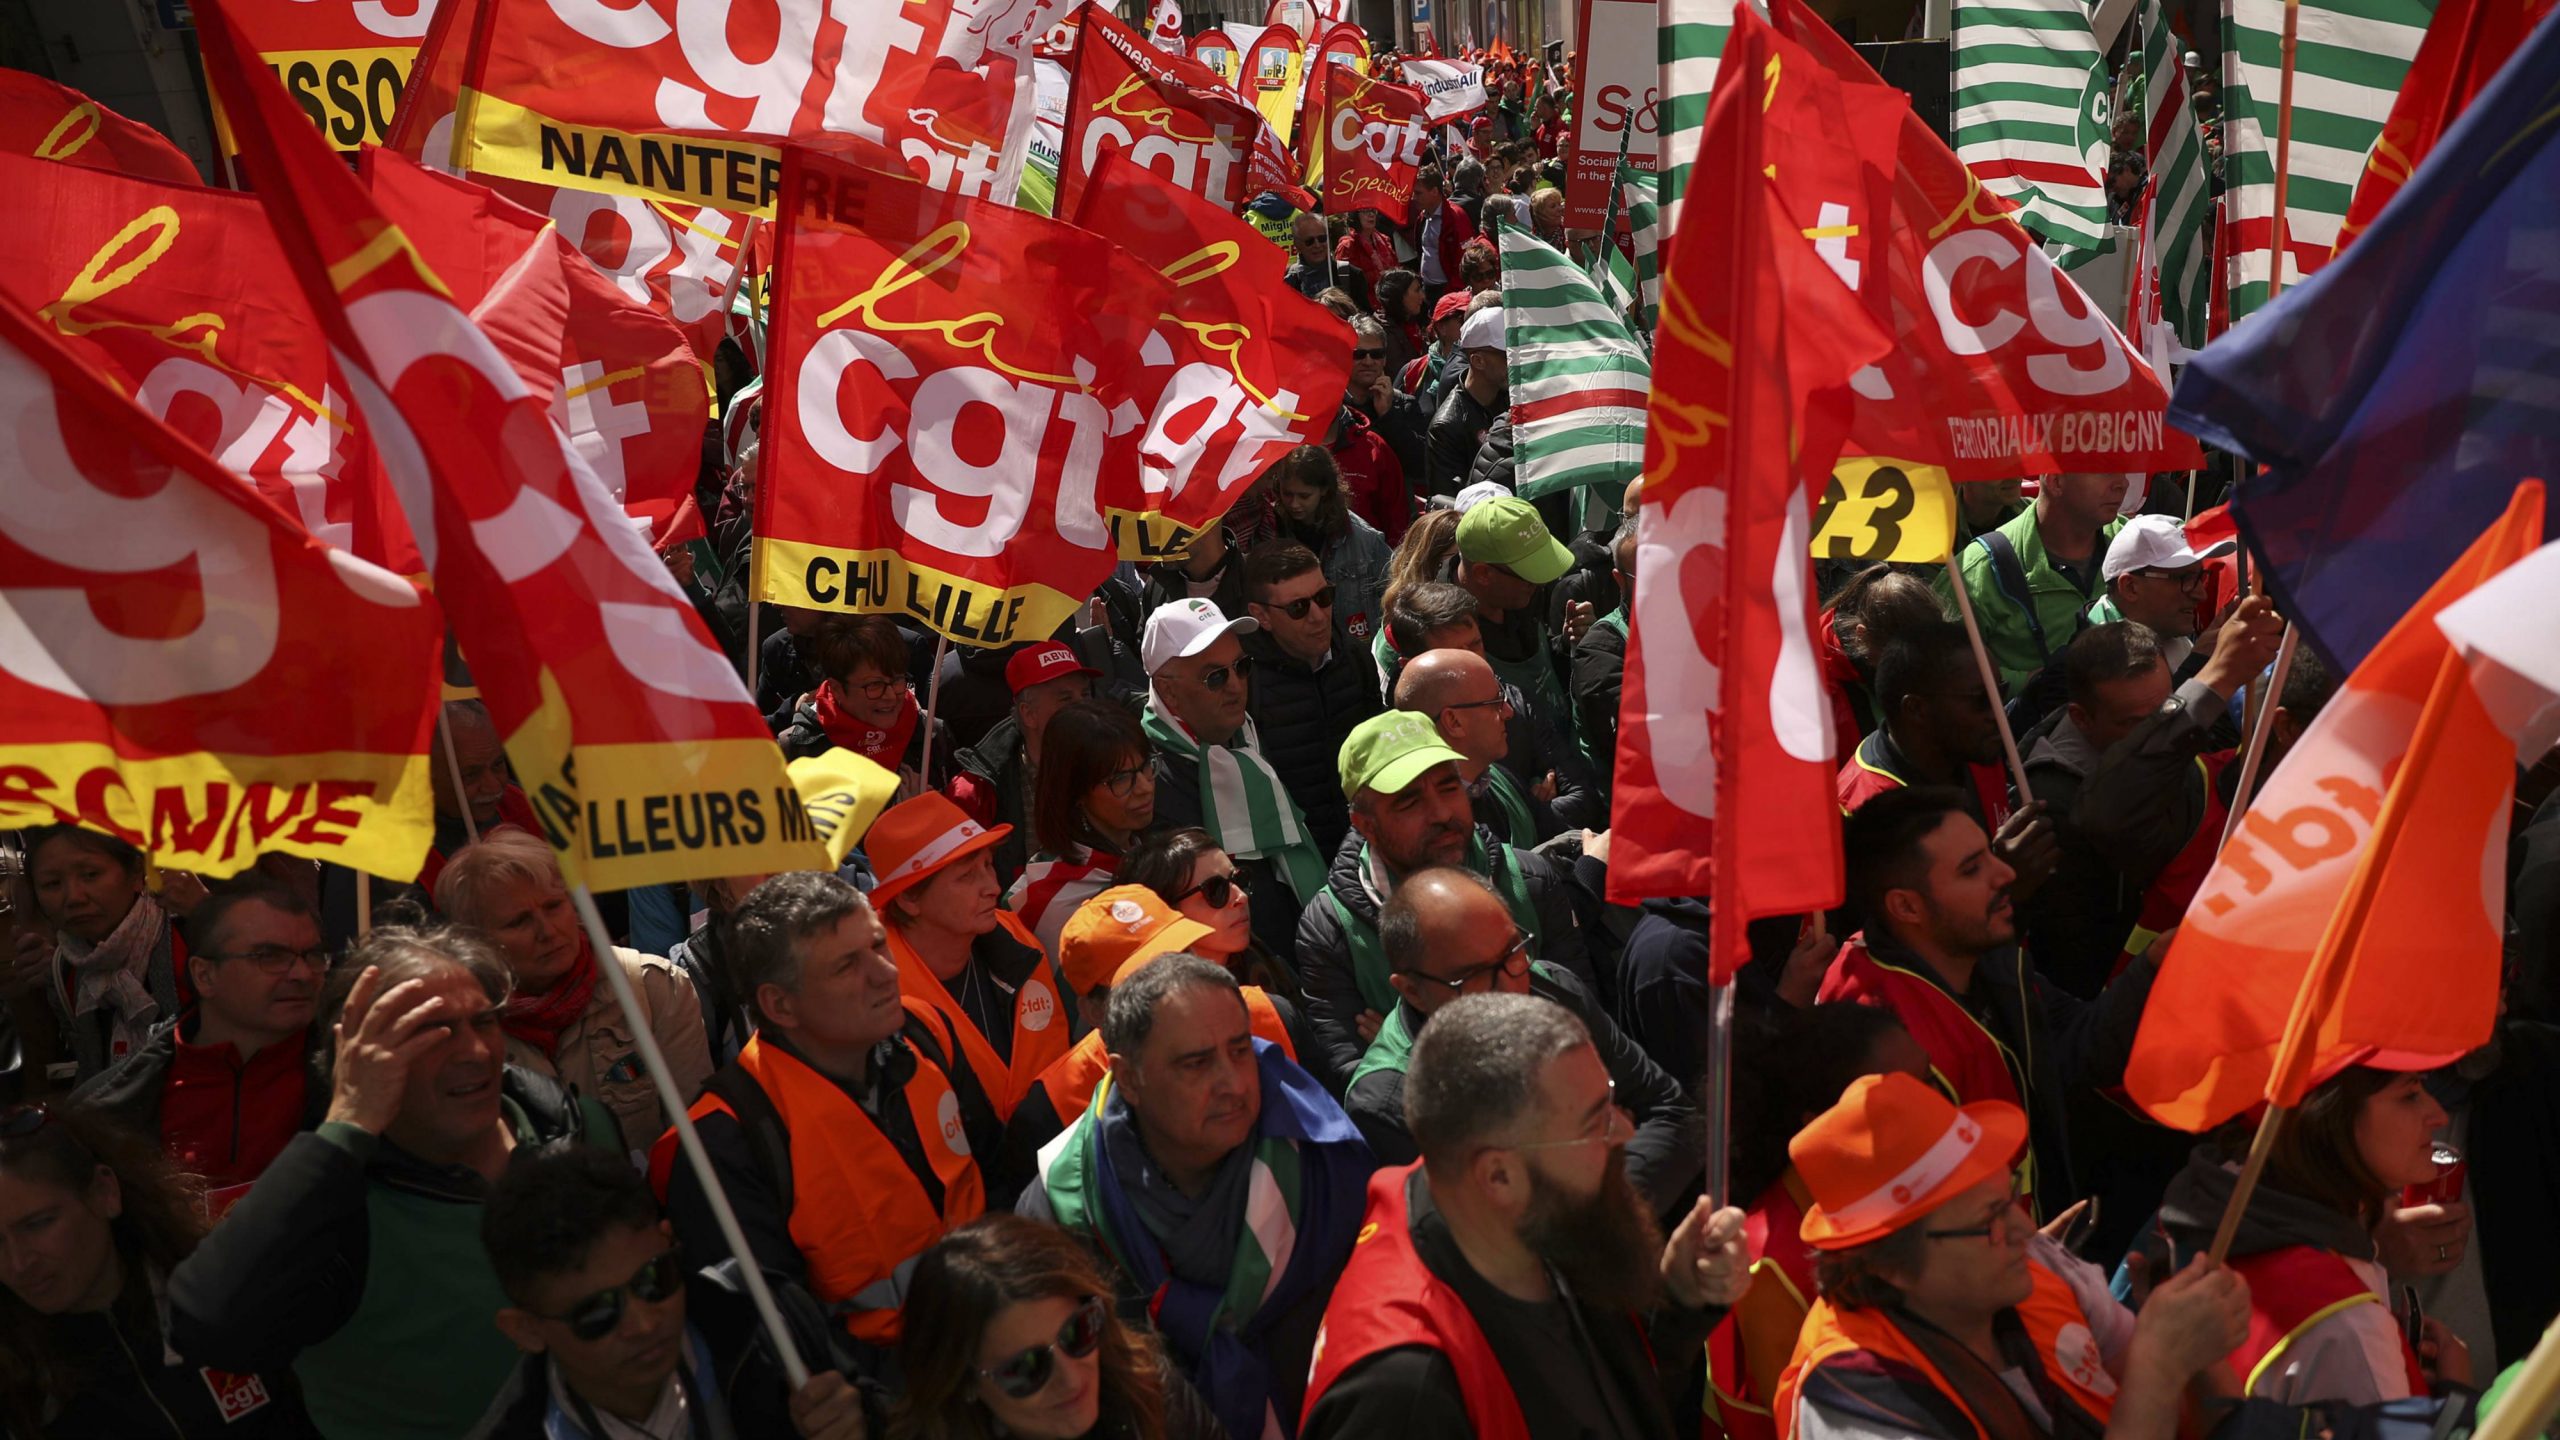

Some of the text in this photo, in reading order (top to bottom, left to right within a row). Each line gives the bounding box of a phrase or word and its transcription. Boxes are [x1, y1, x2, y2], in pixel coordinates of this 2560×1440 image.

[1331, 108, 1427, 171] cgt
[1577, 170, 1586, 180] in
[1589, 171, 1606, 181] the
[1635, 158, 1655, 170] and
[798, 329, 1112, 557] cgt
[2062, 409, 2164, 454] BOBIGNY
[805, 556, 1025, 640] CHU LILLE
[1198, 612, 1216, 622] CISL
[1349, 619, 1369, 636] cgt
[223, 1377, 262, 1410] cgt
